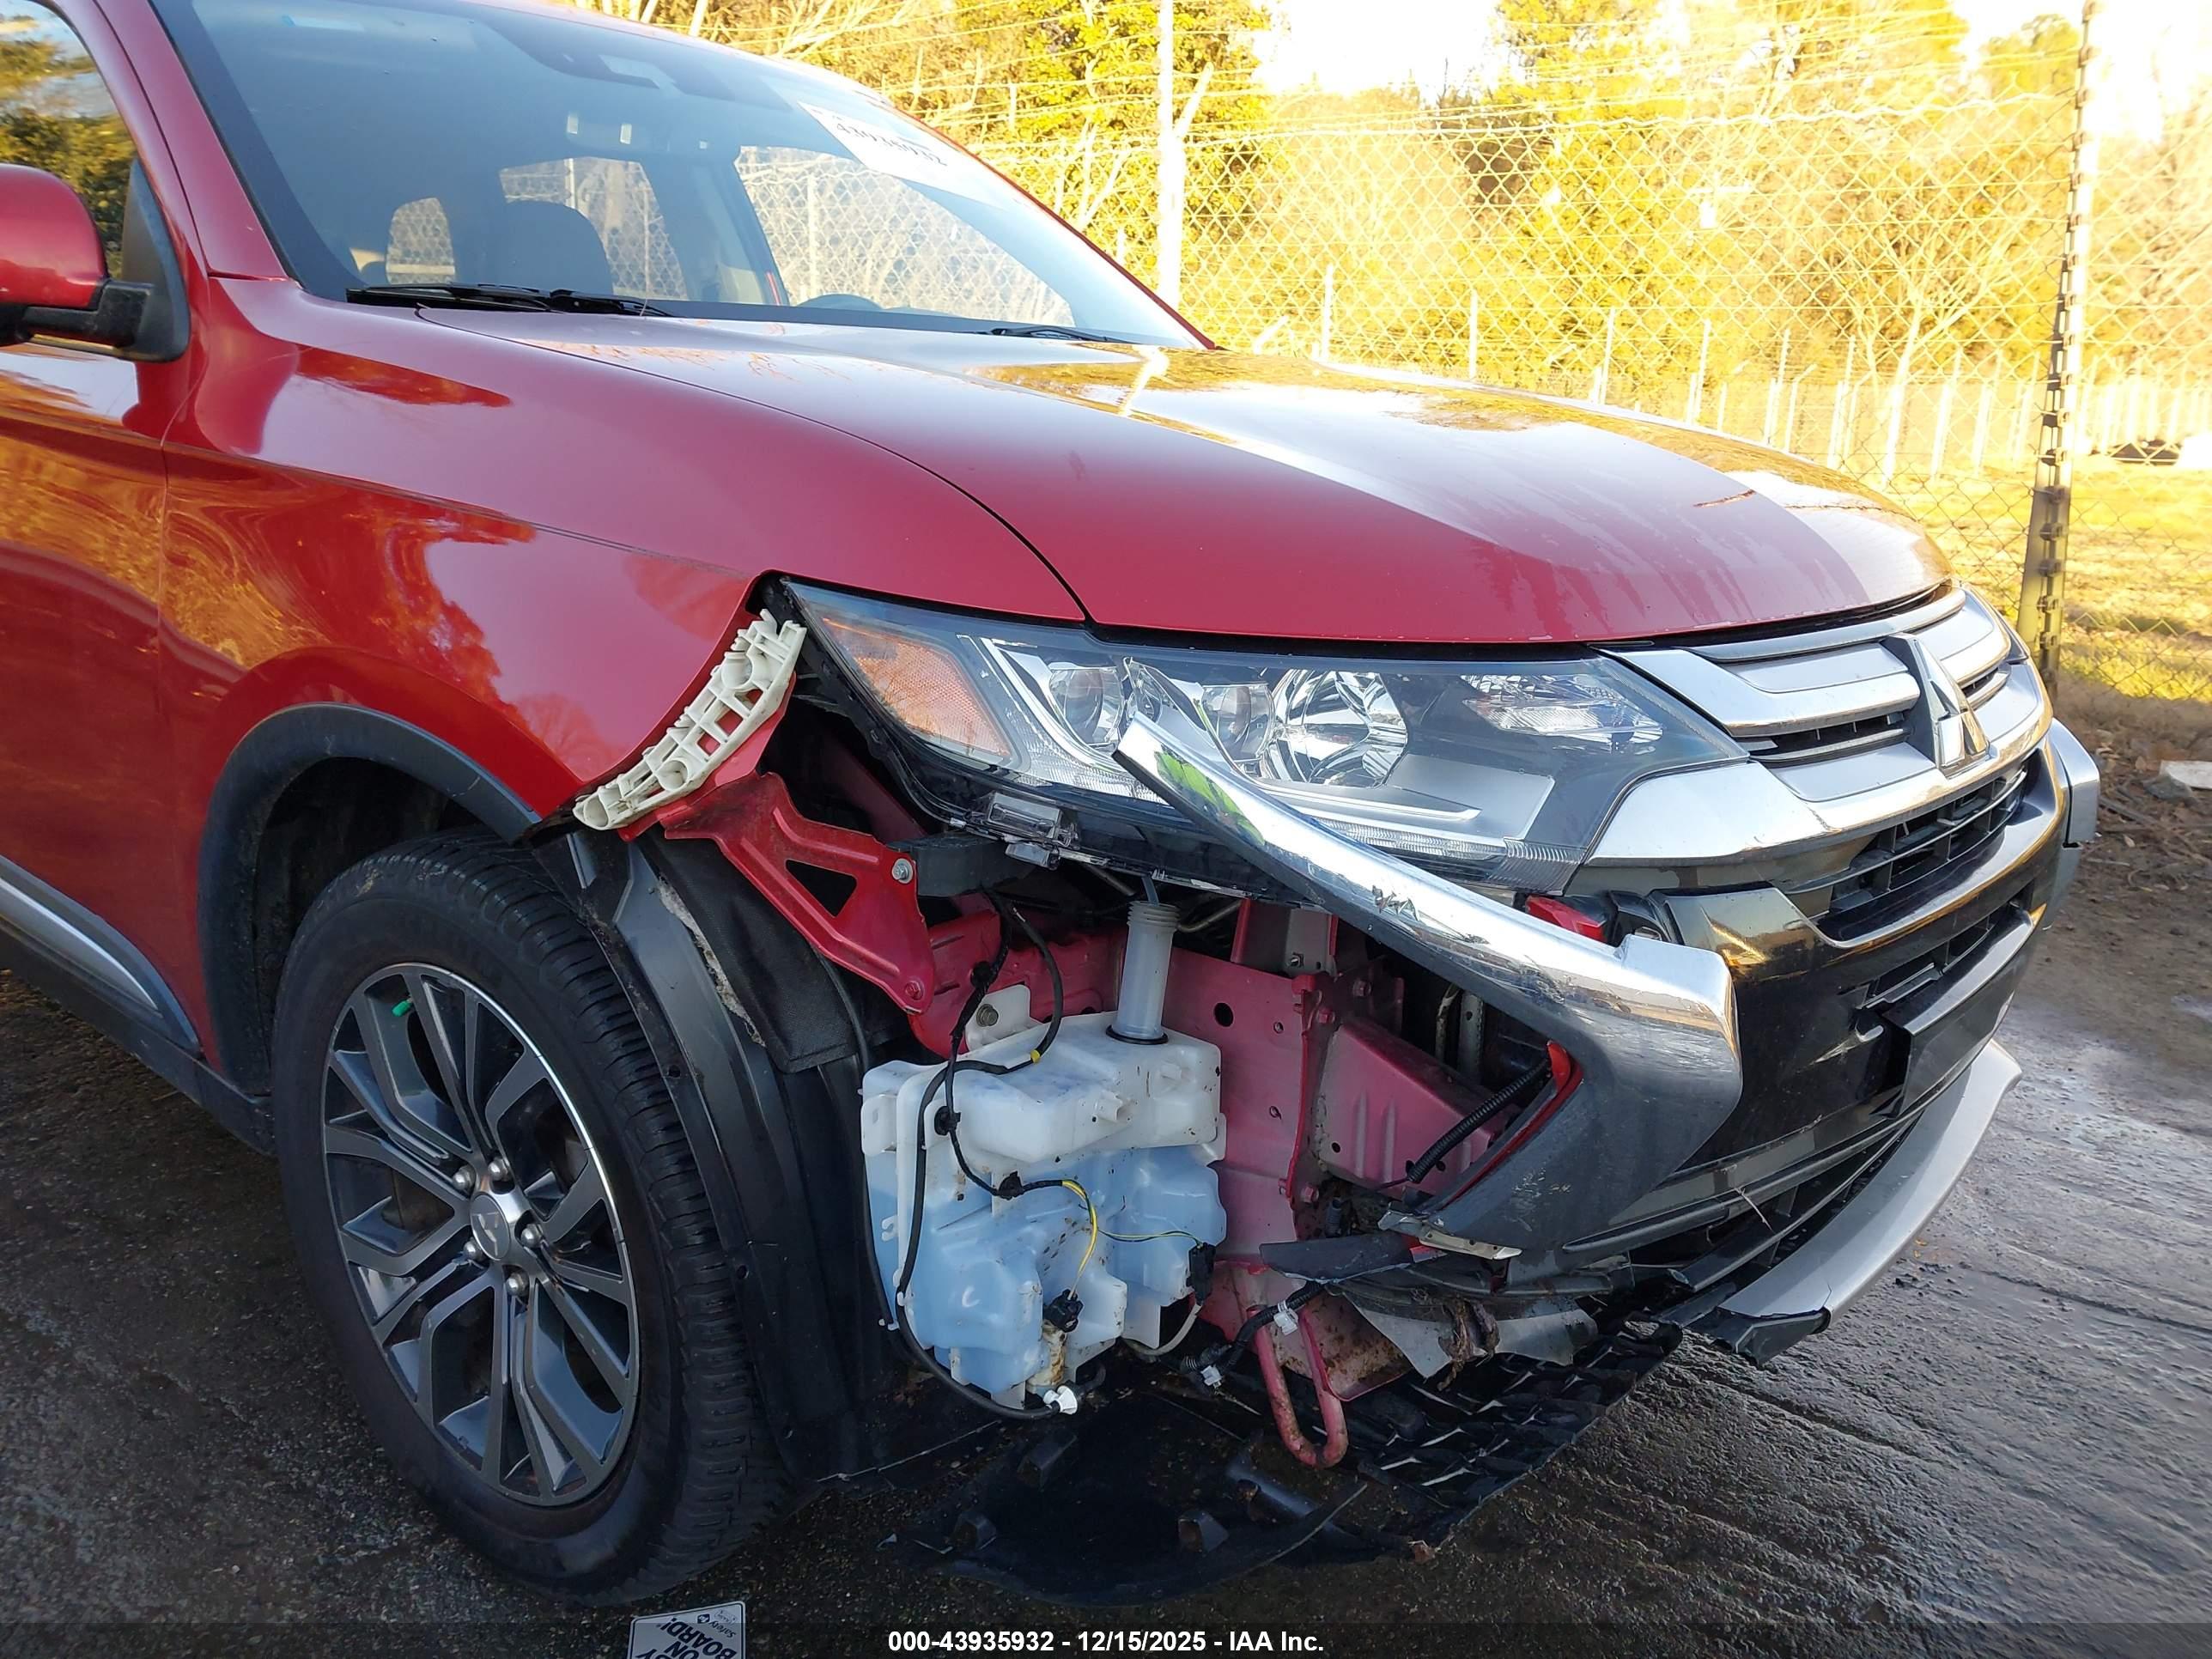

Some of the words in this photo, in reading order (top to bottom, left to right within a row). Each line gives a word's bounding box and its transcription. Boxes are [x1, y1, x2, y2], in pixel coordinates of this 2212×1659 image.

[709, 1620, 736, 1638] Safety
[659, 1618, 737, 1659] BOARD!
[664, 1641, 699, 1659] ON
